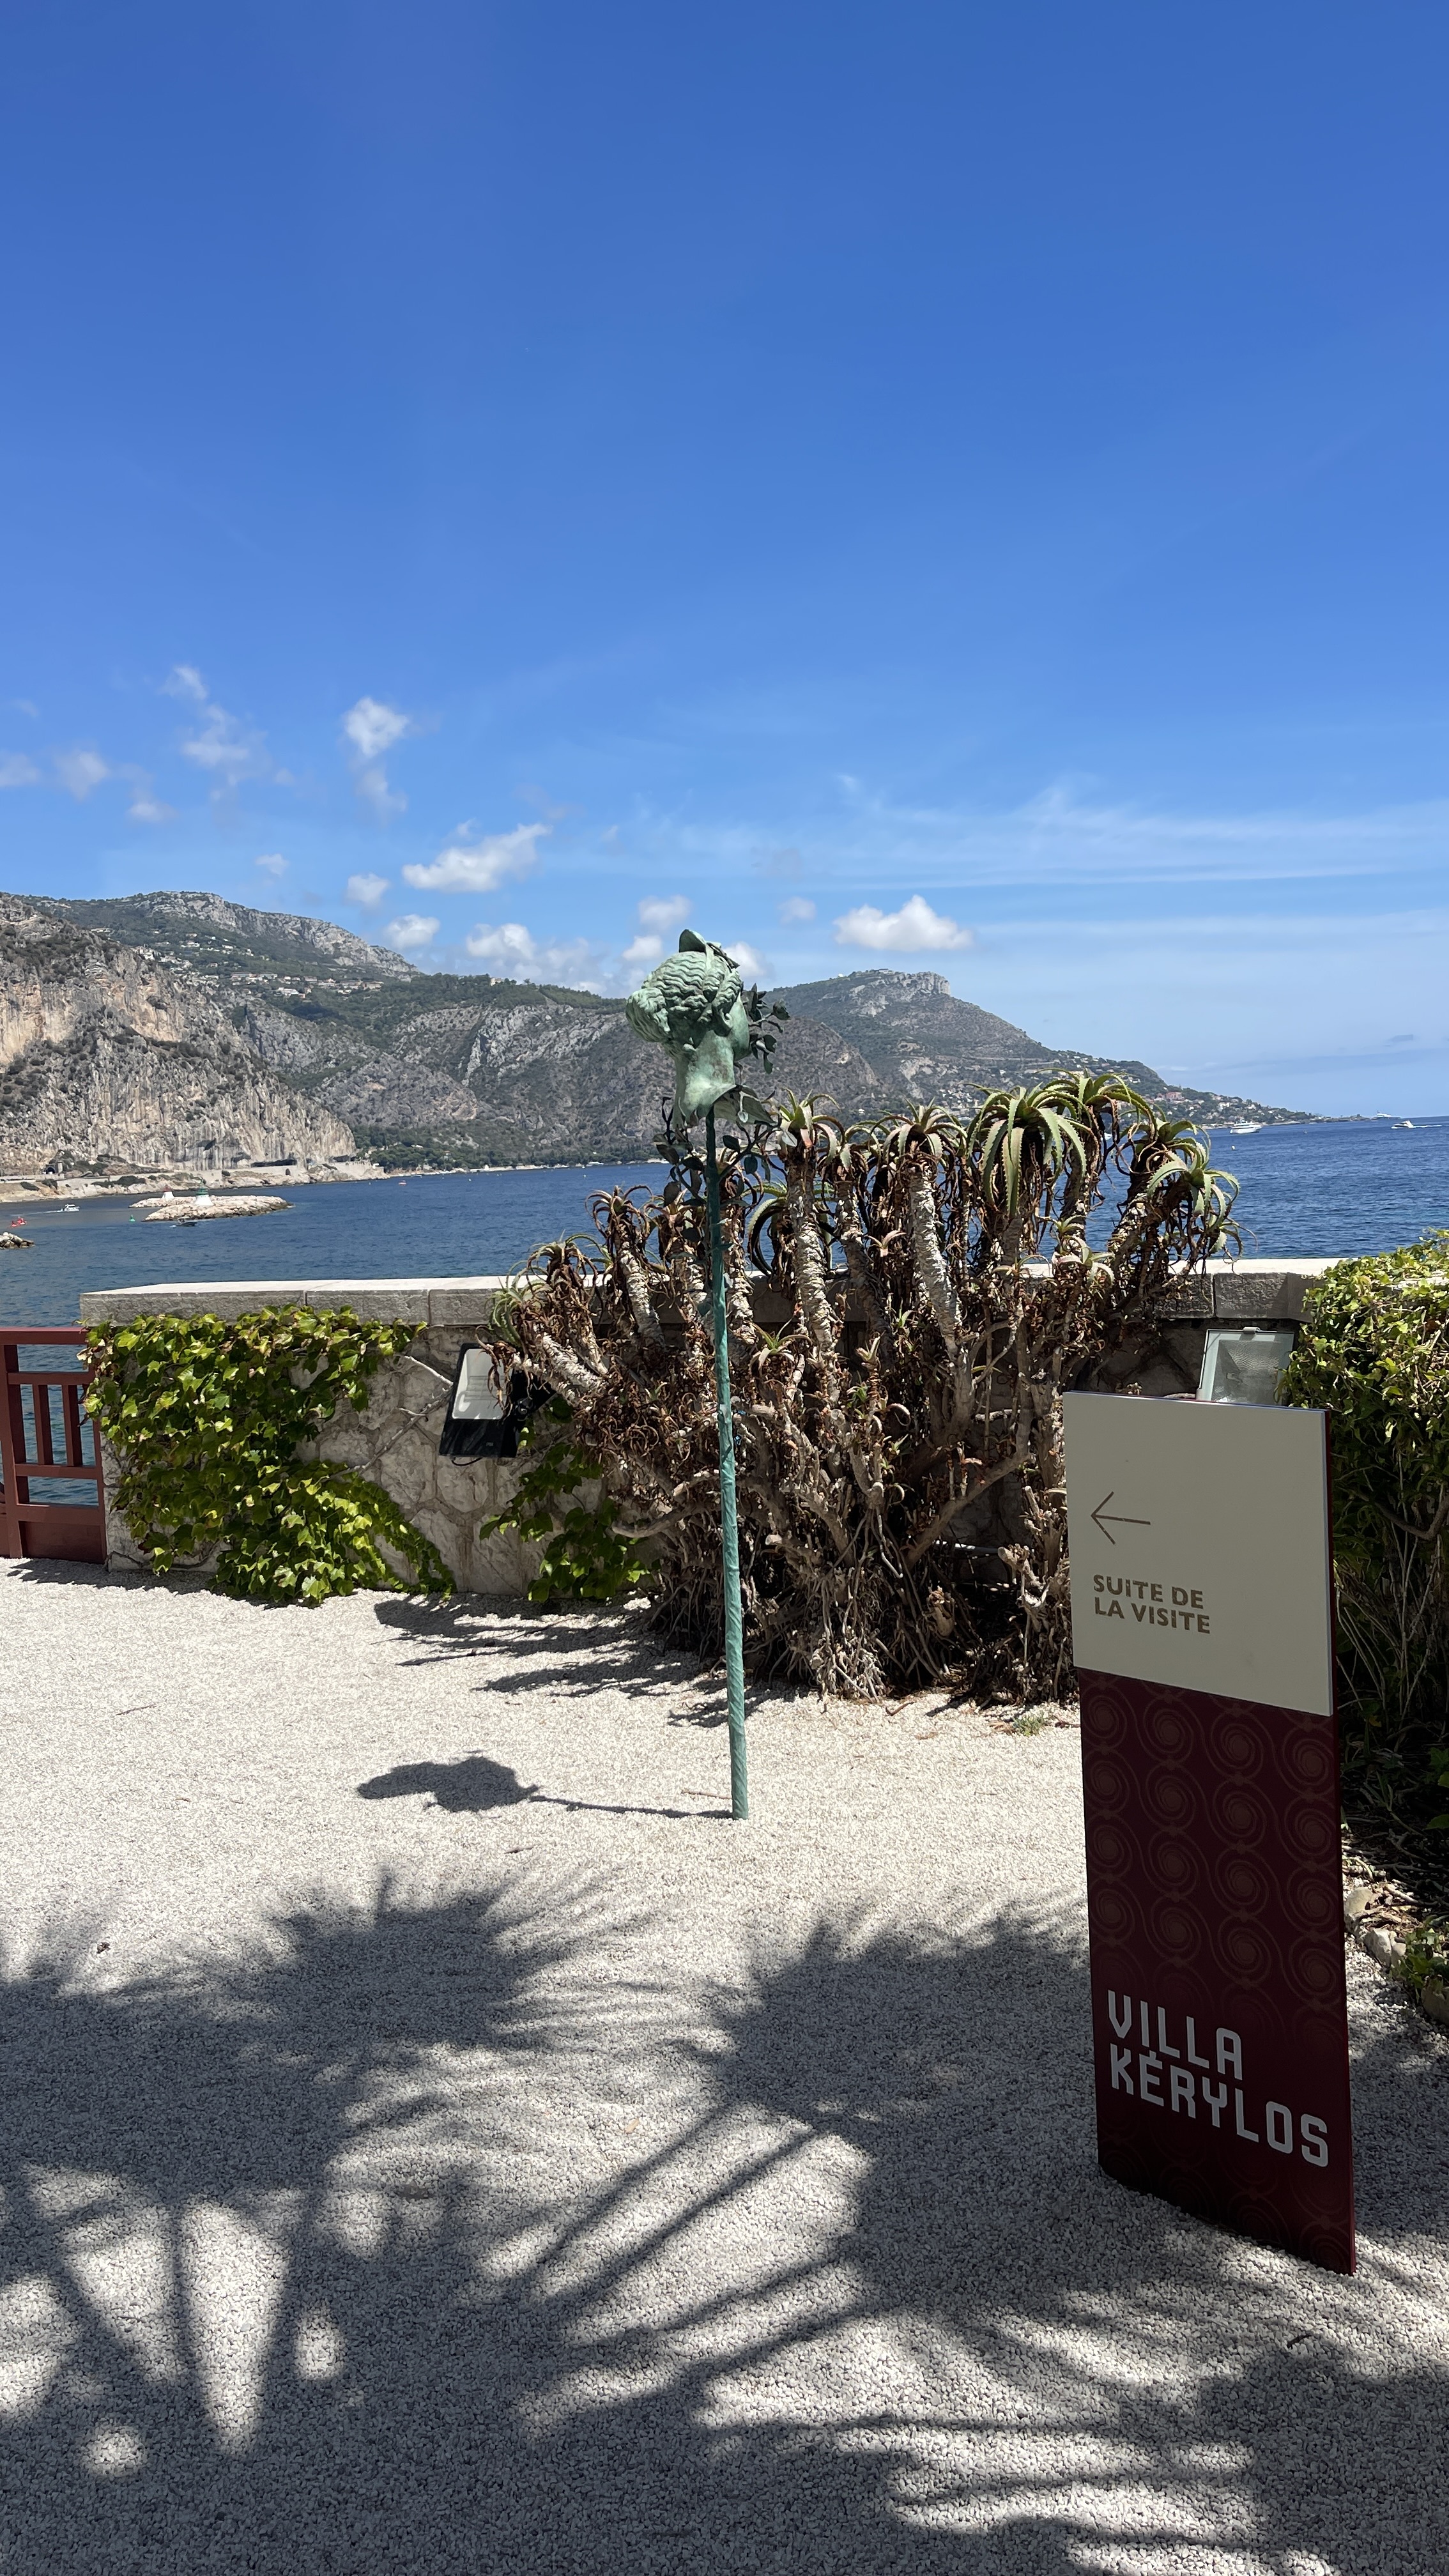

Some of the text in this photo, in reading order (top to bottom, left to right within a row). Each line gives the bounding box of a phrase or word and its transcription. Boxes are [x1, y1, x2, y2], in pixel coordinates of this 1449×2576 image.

[1093, 1574, 1204, 1609] SUITE DE
[1094, 1597, 1210, 1634] LA VISITE
[1108, 1989, 1243, 2080] VILLA
